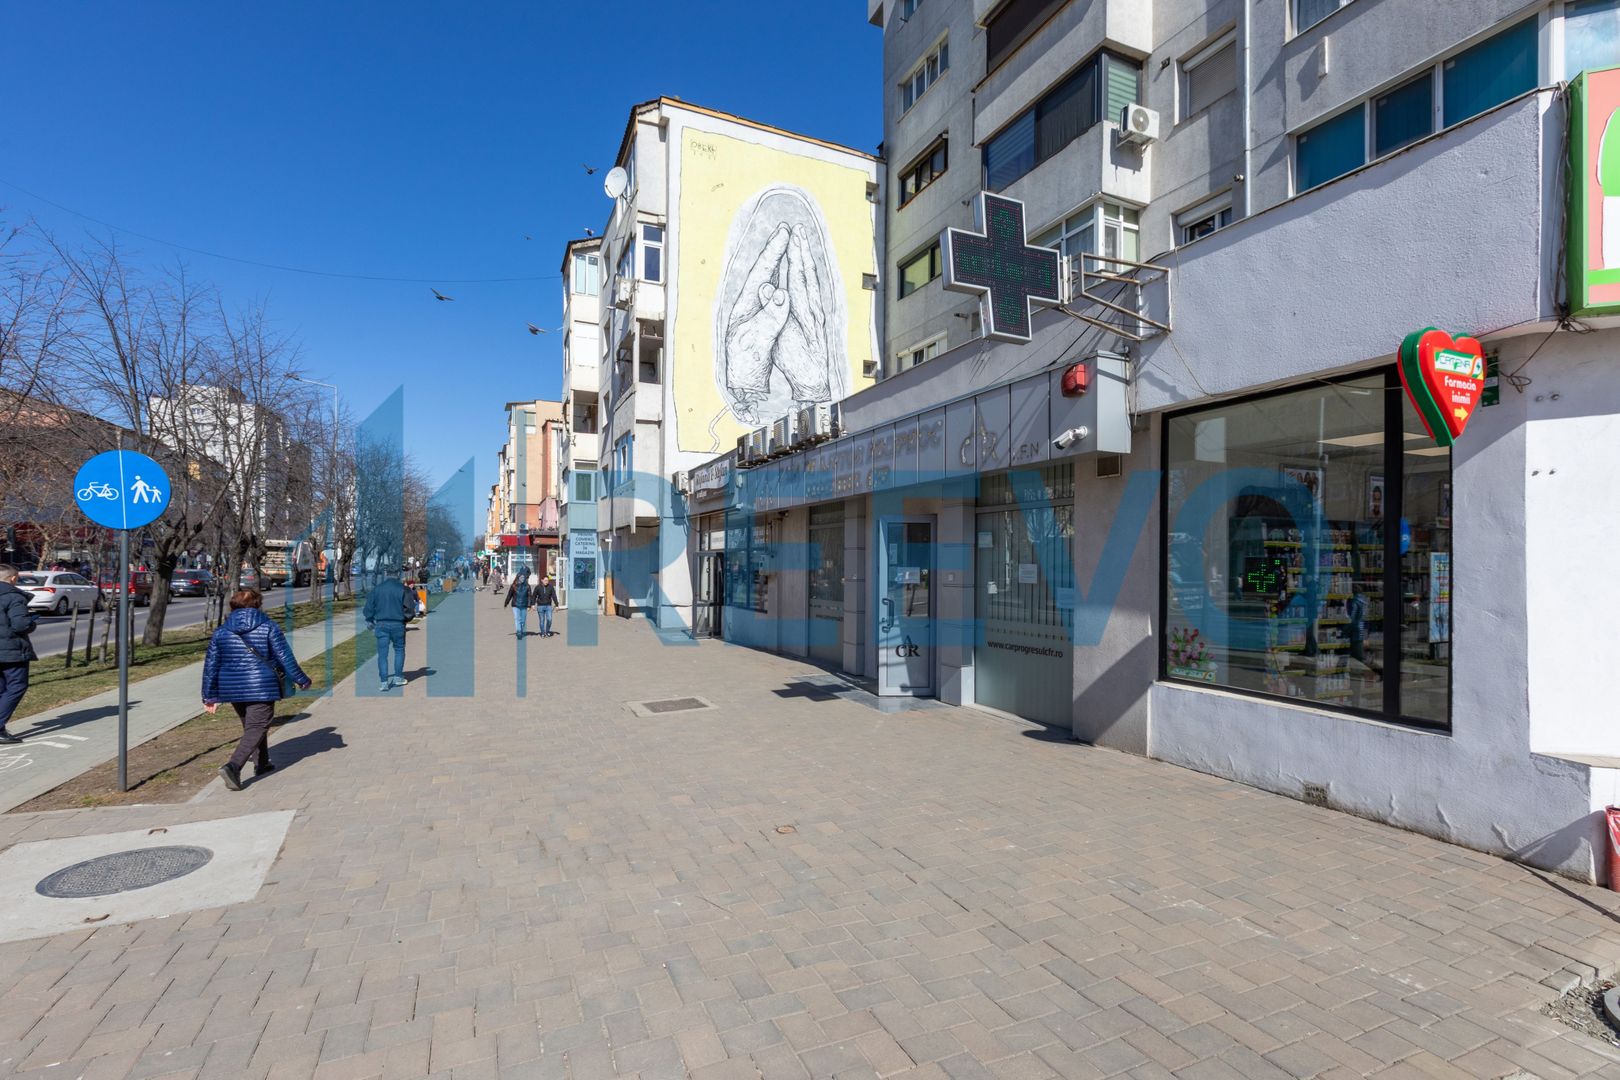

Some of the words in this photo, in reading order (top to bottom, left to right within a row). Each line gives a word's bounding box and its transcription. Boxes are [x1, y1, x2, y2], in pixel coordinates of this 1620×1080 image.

[1444, 376, 1477, 391] Farmacia
[1451, 390, 1471, 404] inimii
[986, 640, 1064, 658] www.carprogresulcfr.ro
